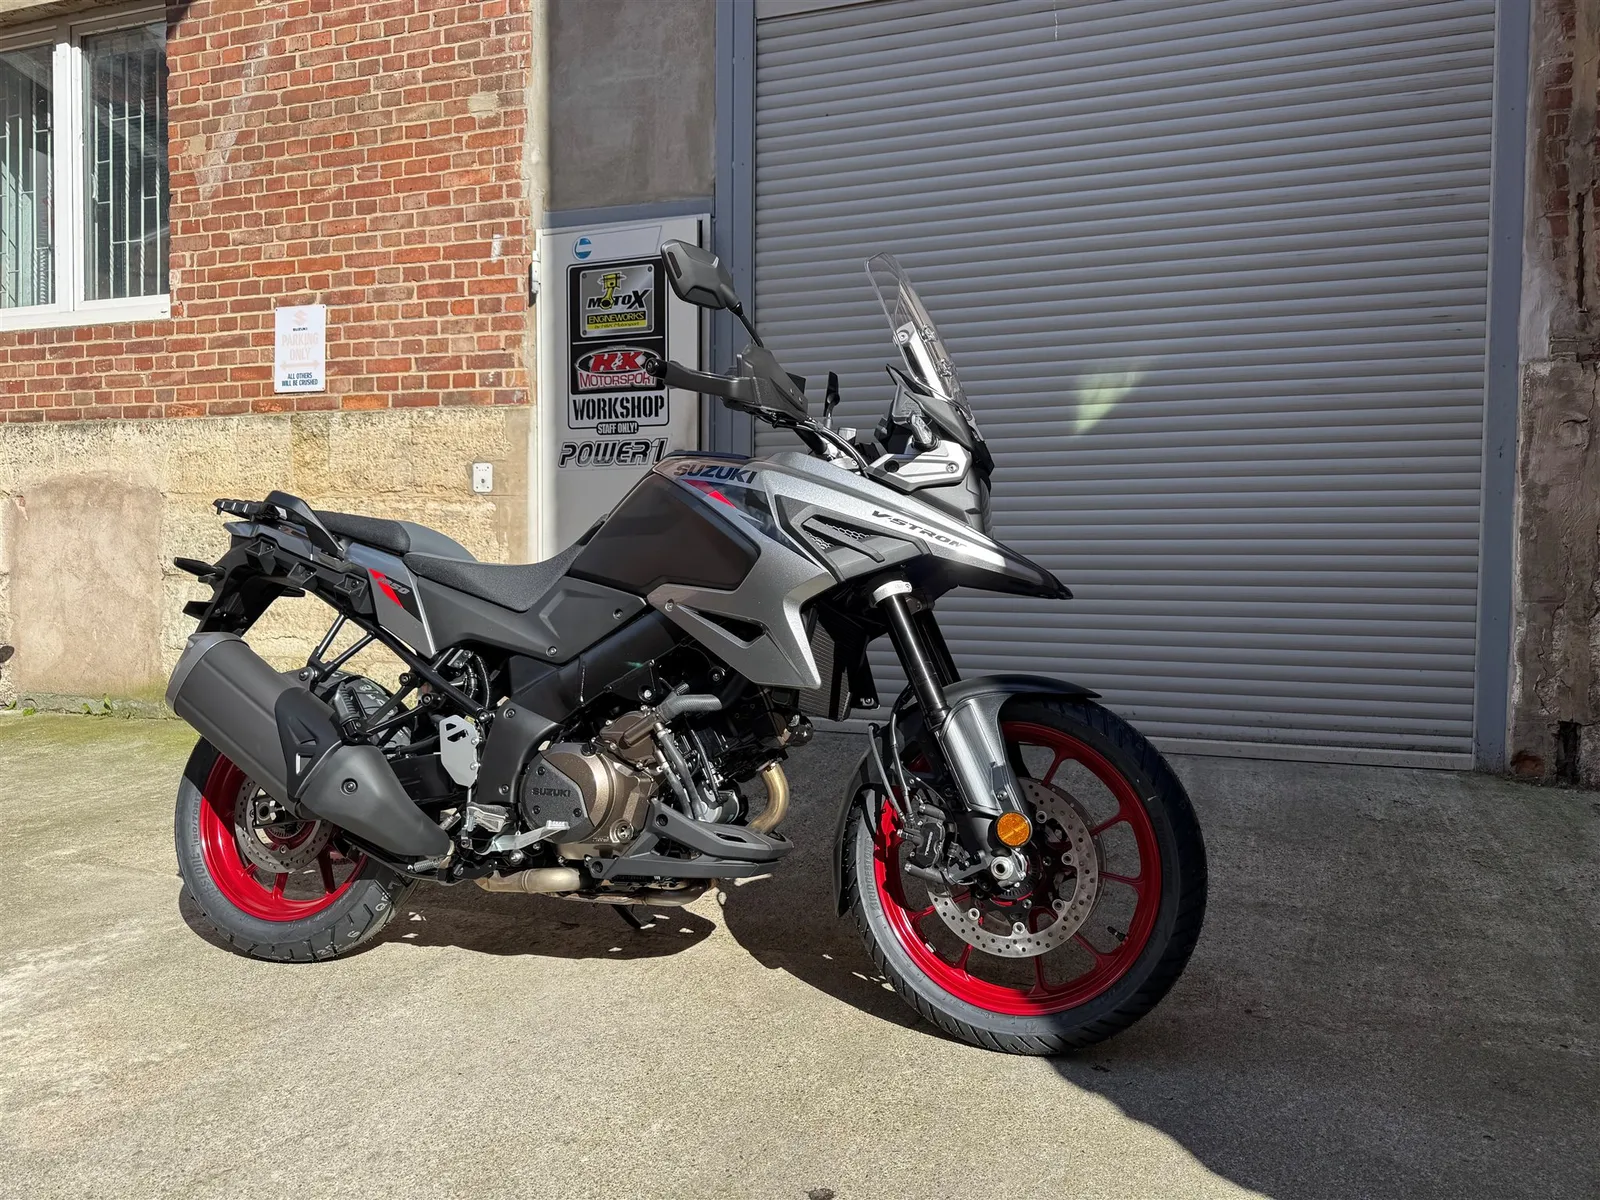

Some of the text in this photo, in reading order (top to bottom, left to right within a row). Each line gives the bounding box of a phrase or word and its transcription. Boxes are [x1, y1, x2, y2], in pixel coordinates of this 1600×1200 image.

[588, 312, 645, 324] ENGINEWORKS
[281, 332, 319, 347] PARKING
[289, 348, 311, 361] ONLY
[590, 351, 643, 373] H&K
[296, 372, 313, 380] OTHERS
[299, 378, 319, 386] CRUSHED
[579, 372, 656, 388] MOTORSPORT
[572, 394, 665, 421] WORKSHOP
[598, 422, 638, 434] STAFF ONLY!
[559, 439, 667, 467] POWER1
[673, 464, 758, 484] SUZUKI
[532, 787, 571, 797] SUZUKI
